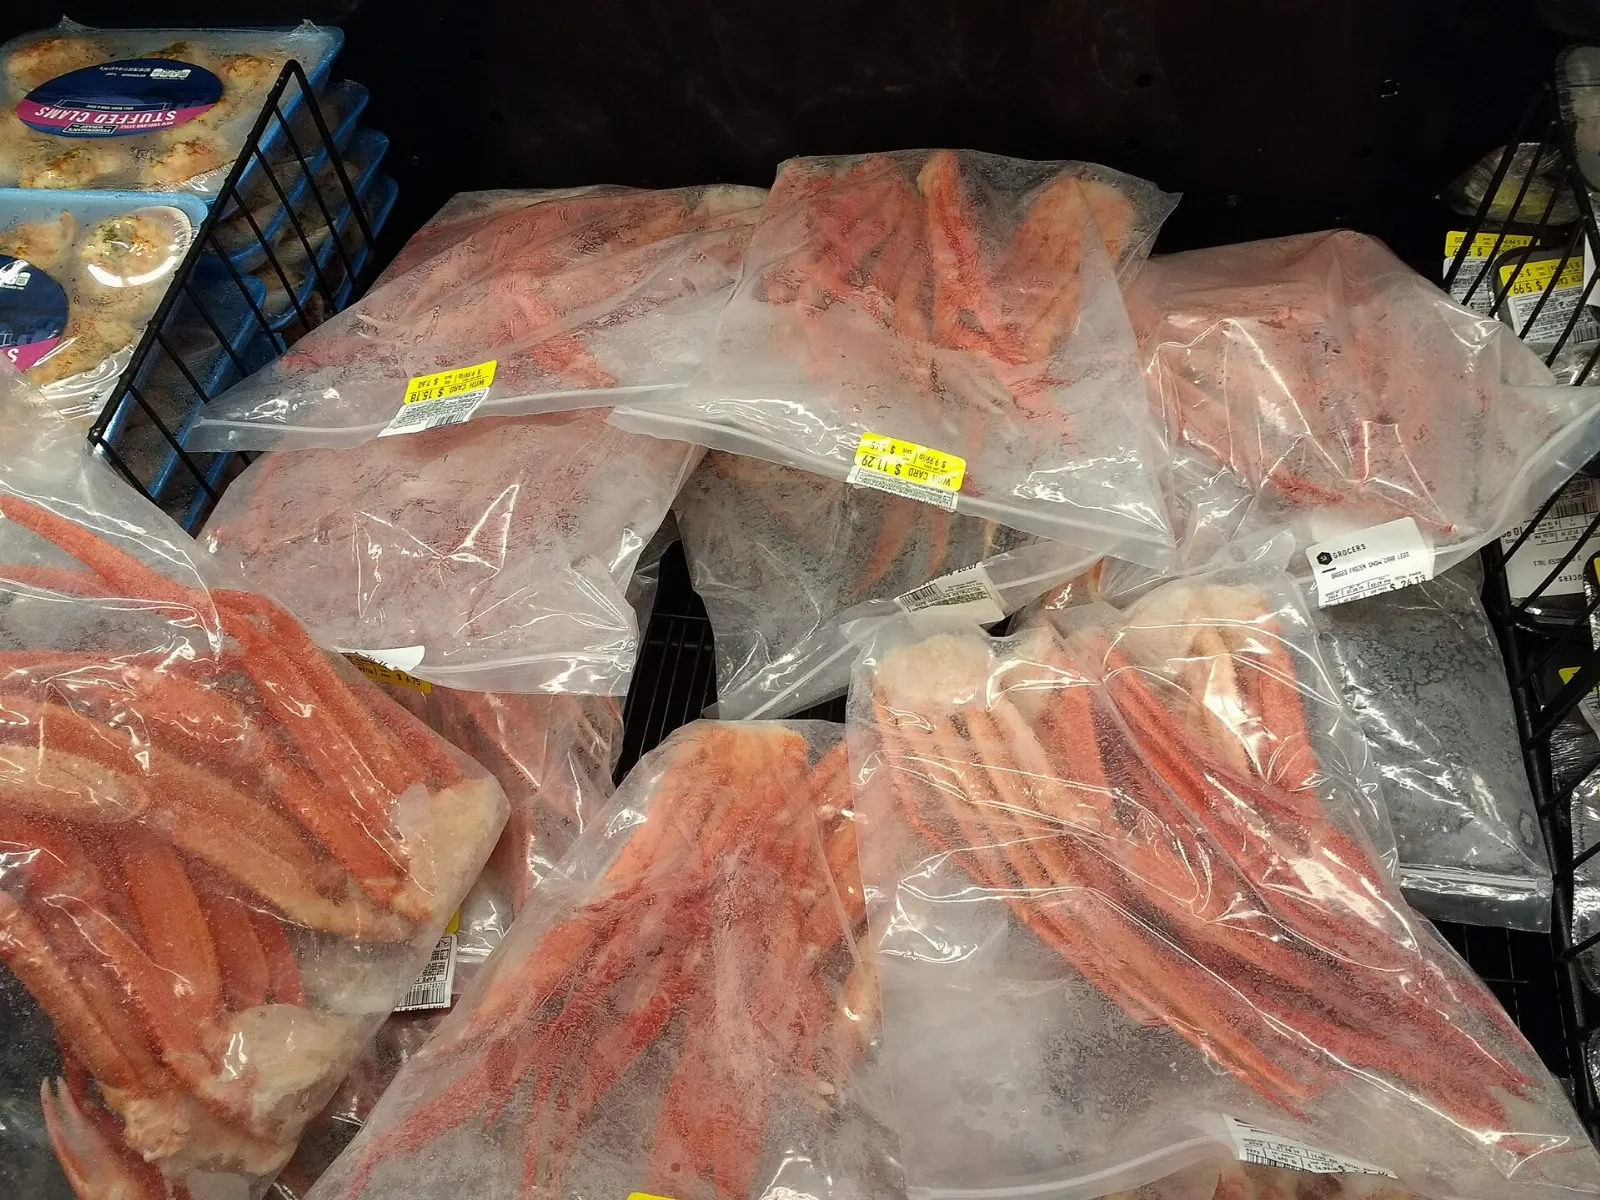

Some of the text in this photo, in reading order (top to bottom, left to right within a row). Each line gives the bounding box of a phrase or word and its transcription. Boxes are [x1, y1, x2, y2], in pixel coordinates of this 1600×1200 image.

[34, 106, 177, 124] STUFFED CLAMS
[1513, 283, 1532, 294] 5.99
[1536, 281, 1542, 291] $
[410, 379, 485, 402] WITH CARD $ 15.18
[890, 445, 896, 454] $
[861, 455, 888, 472] 11.29
[894, 463, 902, 476] $
[908, 468, 928, 480] CARD
[1332, 543, 1367, 559] GROCERS
[1349, 564, 1367, 574] FROZEN
[1369, 558, 1383, 568] SNOW
[1384, 555, 1396, 564] CRAB
[1398, 552, 1410, 560] LEGS
[1558, 574, 1584, 582] OCERS
[406, 676, 421, 685] 6.75
